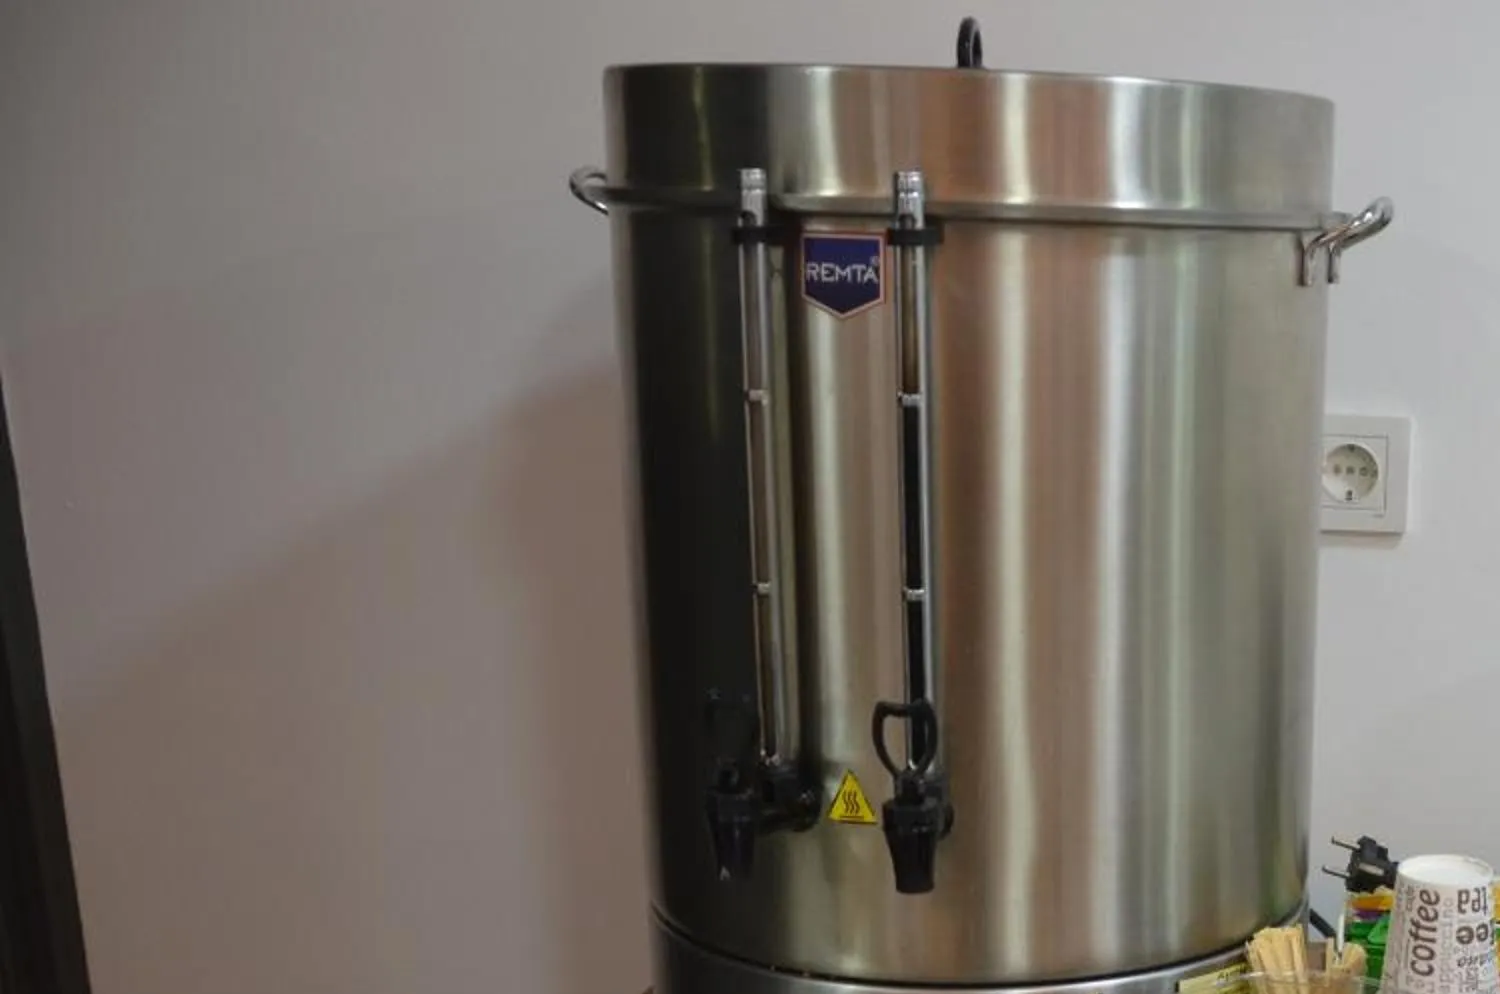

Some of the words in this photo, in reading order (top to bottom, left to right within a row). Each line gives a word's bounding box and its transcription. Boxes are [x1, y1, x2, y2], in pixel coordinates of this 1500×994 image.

[806, 261, 879, 284] REMTA
[1457, 886, 1488, 915] tea
[1409, 888, 1441, 977] coffee
